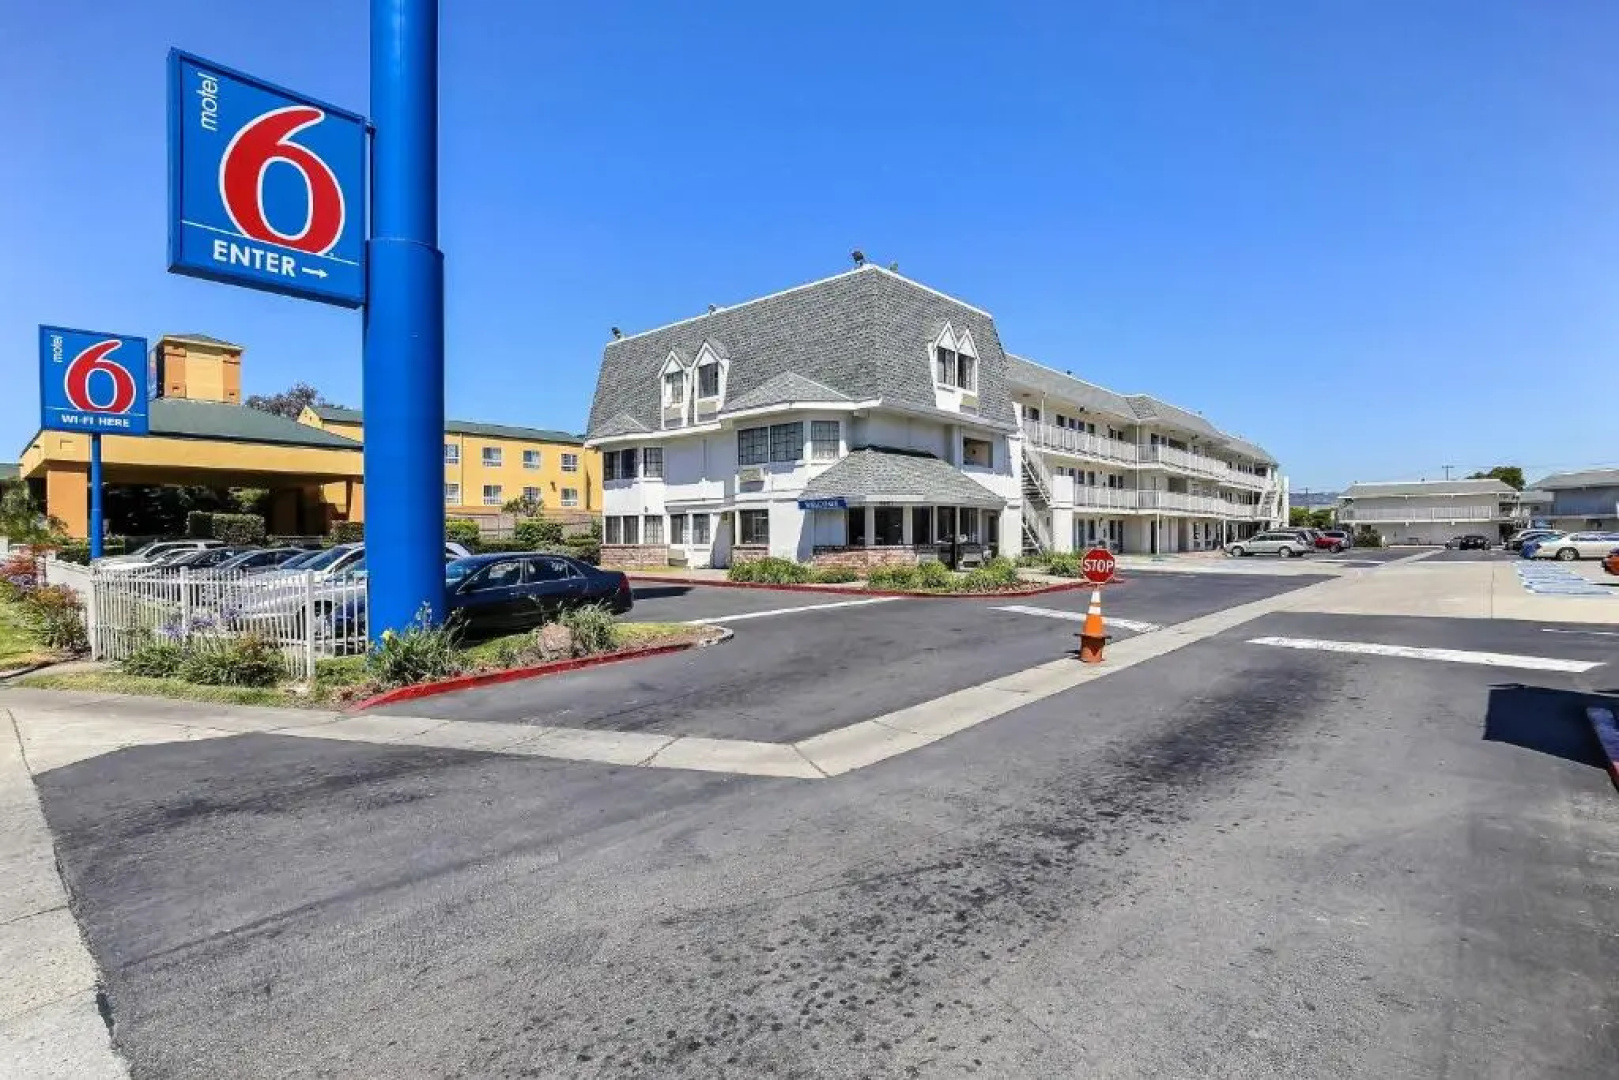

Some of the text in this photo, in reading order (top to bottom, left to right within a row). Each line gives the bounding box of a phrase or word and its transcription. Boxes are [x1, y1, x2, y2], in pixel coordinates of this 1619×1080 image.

[196, 72, 218, 131] motel
[219, 105, 346, 257] 6
[212, 239, 296, 277] ENTER
[50, 334, 63, 363] motel
[64, 339, 136, 415] 6
[61, 413, 131, 428] WI-FI HERE
[1083, 559, 1114, 573] STOP
